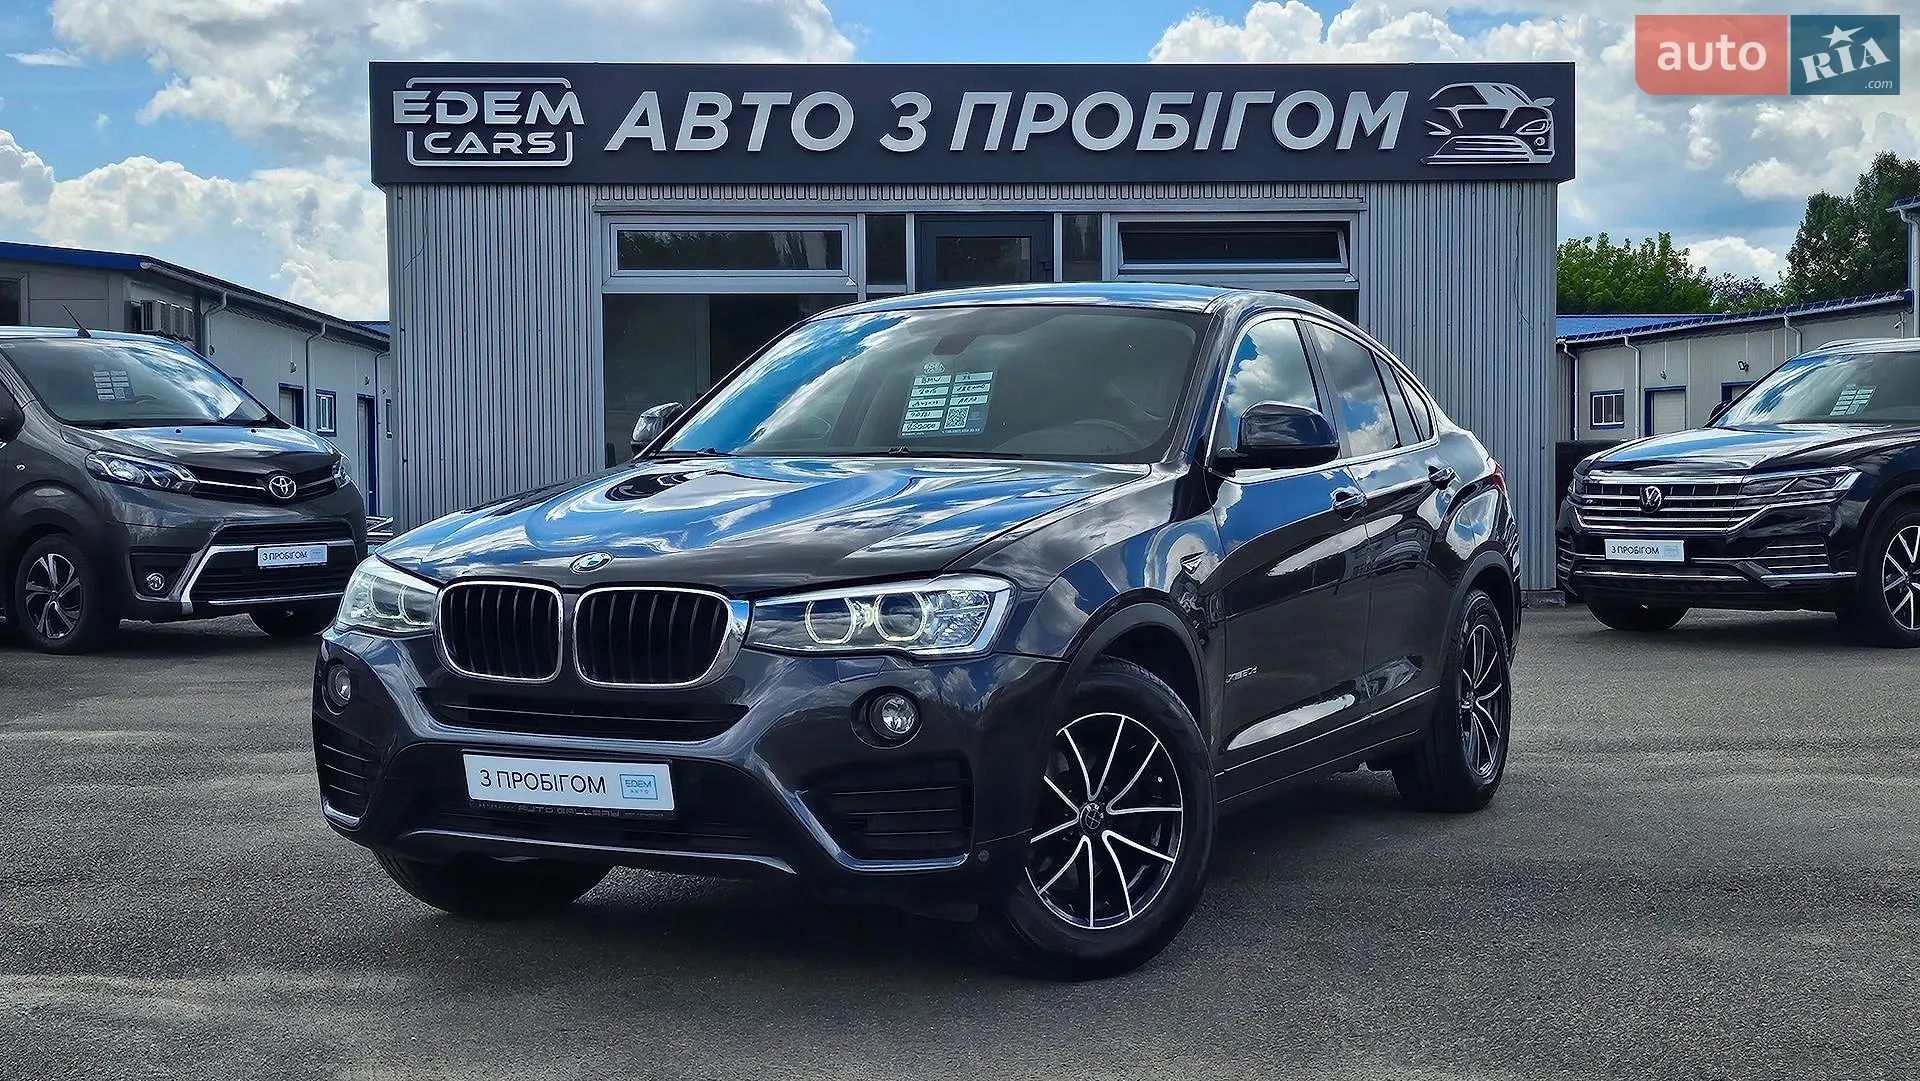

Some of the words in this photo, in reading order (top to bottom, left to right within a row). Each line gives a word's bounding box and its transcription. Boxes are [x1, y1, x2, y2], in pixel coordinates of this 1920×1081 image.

[392, 90, 585, 126] EDEM
[604, 91, 855, 152] АВТО
[950, 91, 1409, 153] ПРОБІГОМ
[424, 132, 555, 155] CARS
[496, 770, 607, 795] ПРОБІГОМ
